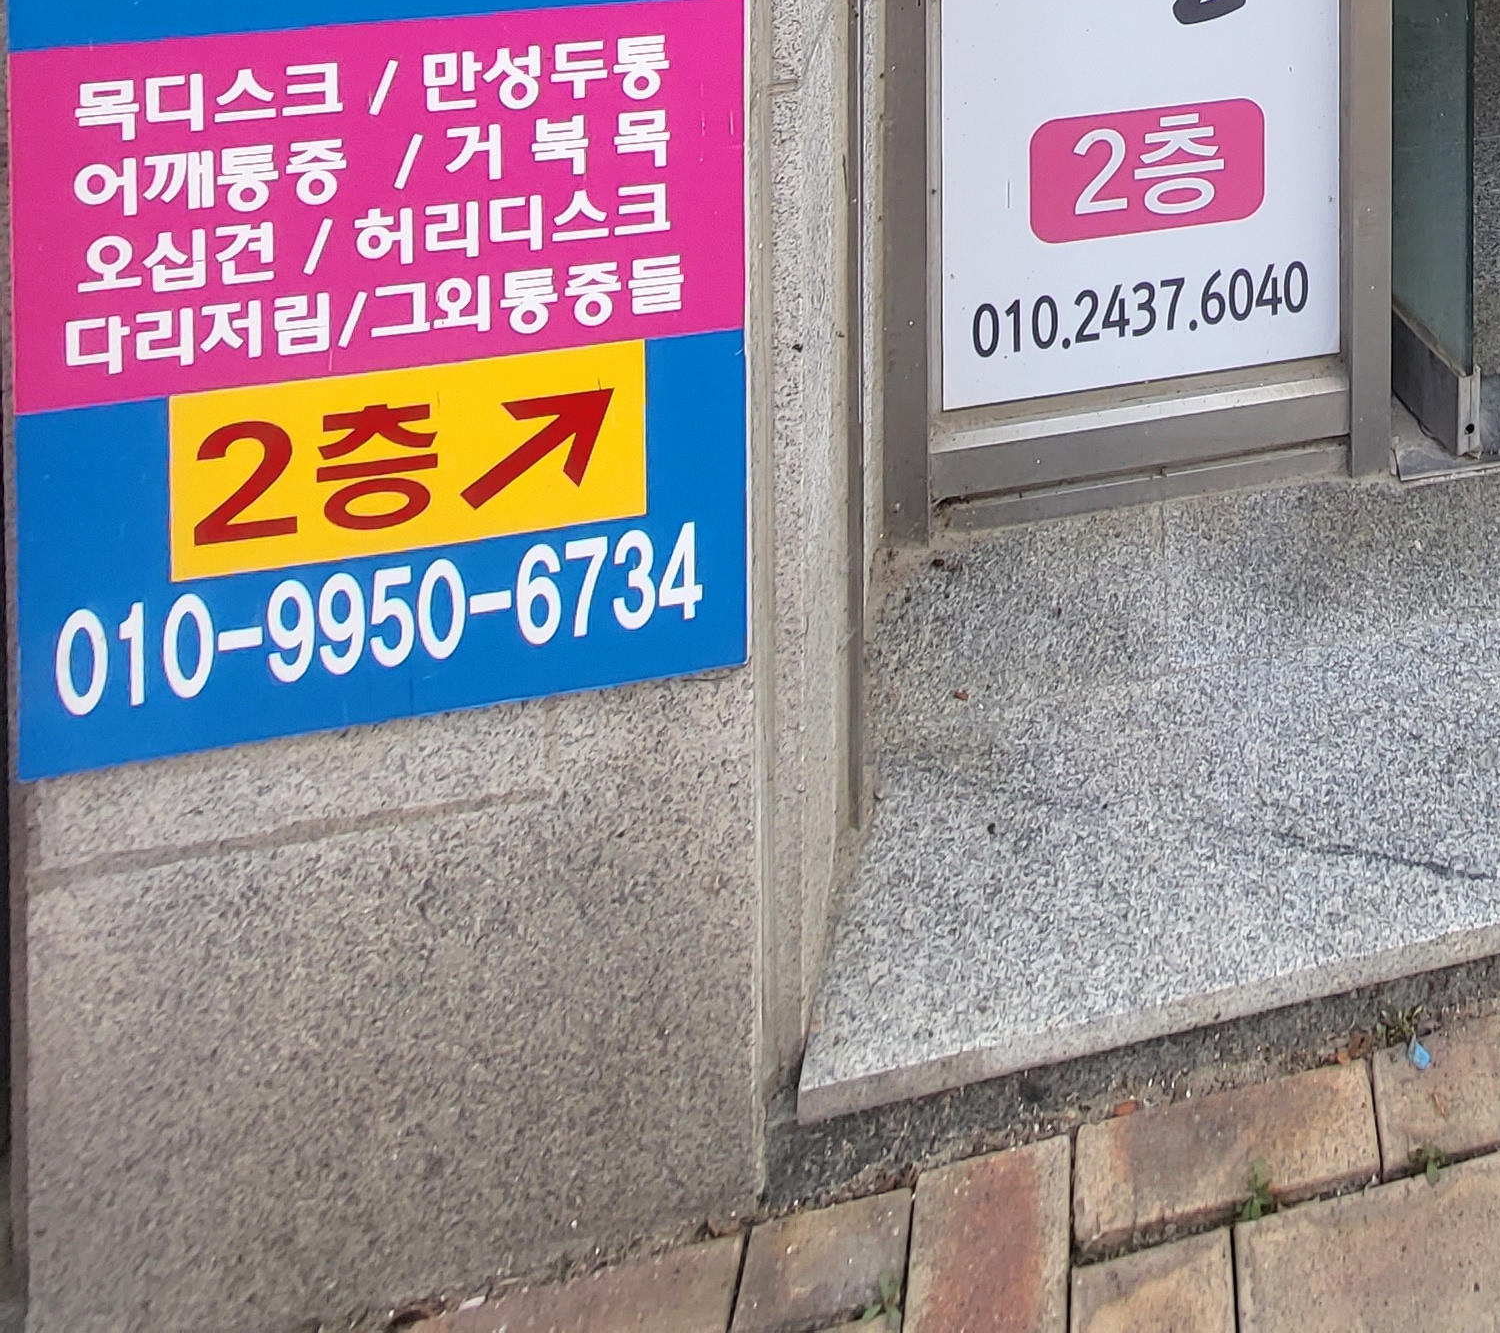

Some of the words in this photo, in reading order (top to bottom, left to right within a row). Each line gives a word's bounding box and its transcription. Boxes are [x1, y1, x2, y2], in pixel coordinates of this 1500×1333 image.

[74, 62, 344, 141] 목디스크
[423, 34, 670, 112] 만성두통
[73, 138, 347, 216] 어깨통증
[1072, 113, 1225, 215] 2층
[77, 221, 275, 293] 오십견
[354, 183, 671, 265] 허리디스크
[972, 260, 1309, 358] 010.2437.6040
[194, 403, 438, 547] 2층
[56, 521, 703, 715] 010-9950-6734
